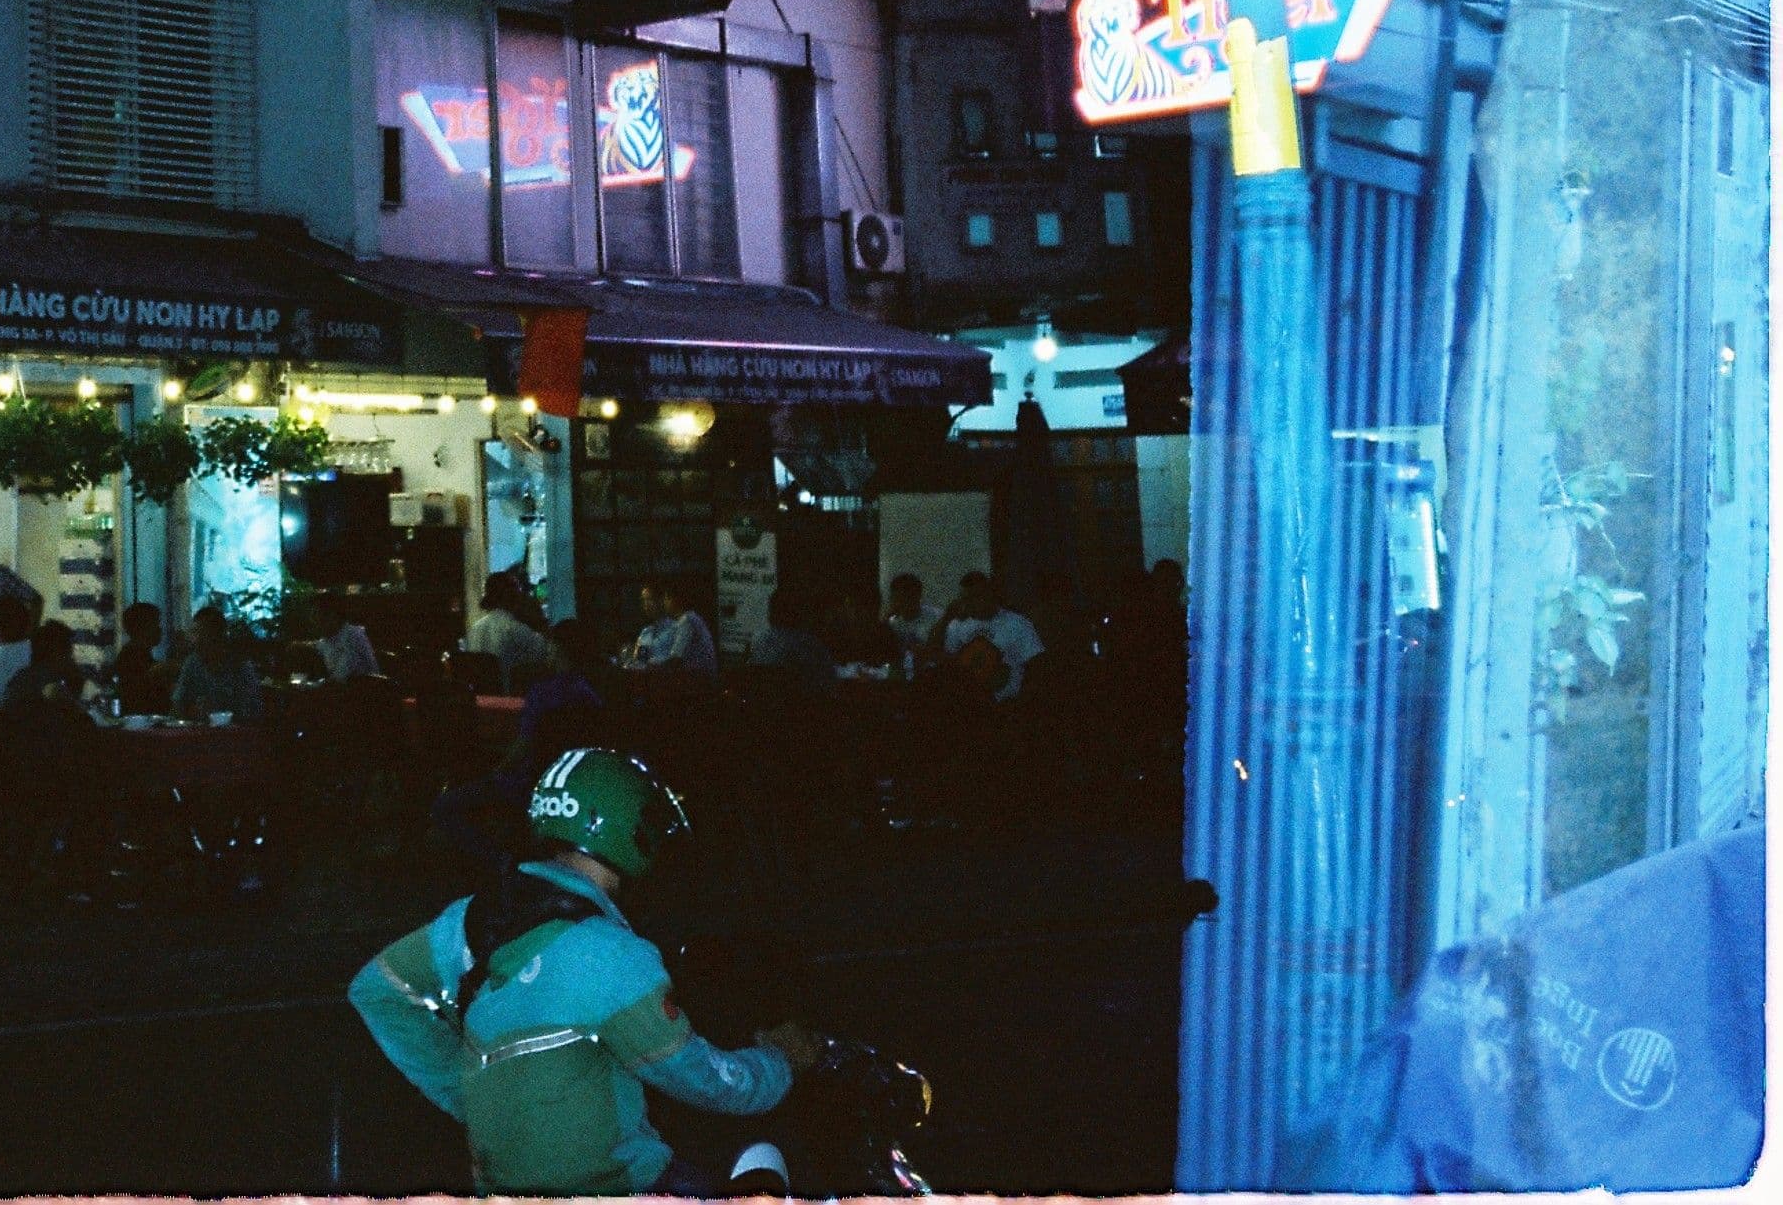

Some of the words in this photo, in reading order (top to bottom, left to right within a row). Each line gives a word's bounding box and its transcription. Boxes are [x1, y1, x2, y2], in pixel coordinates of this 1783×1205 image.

[72, 289, 131, 324] CỪU
[135, 299, 192, 328] NON
[198, 303, 231, 330] HY
[235, 305, 281, 340] LẠP
